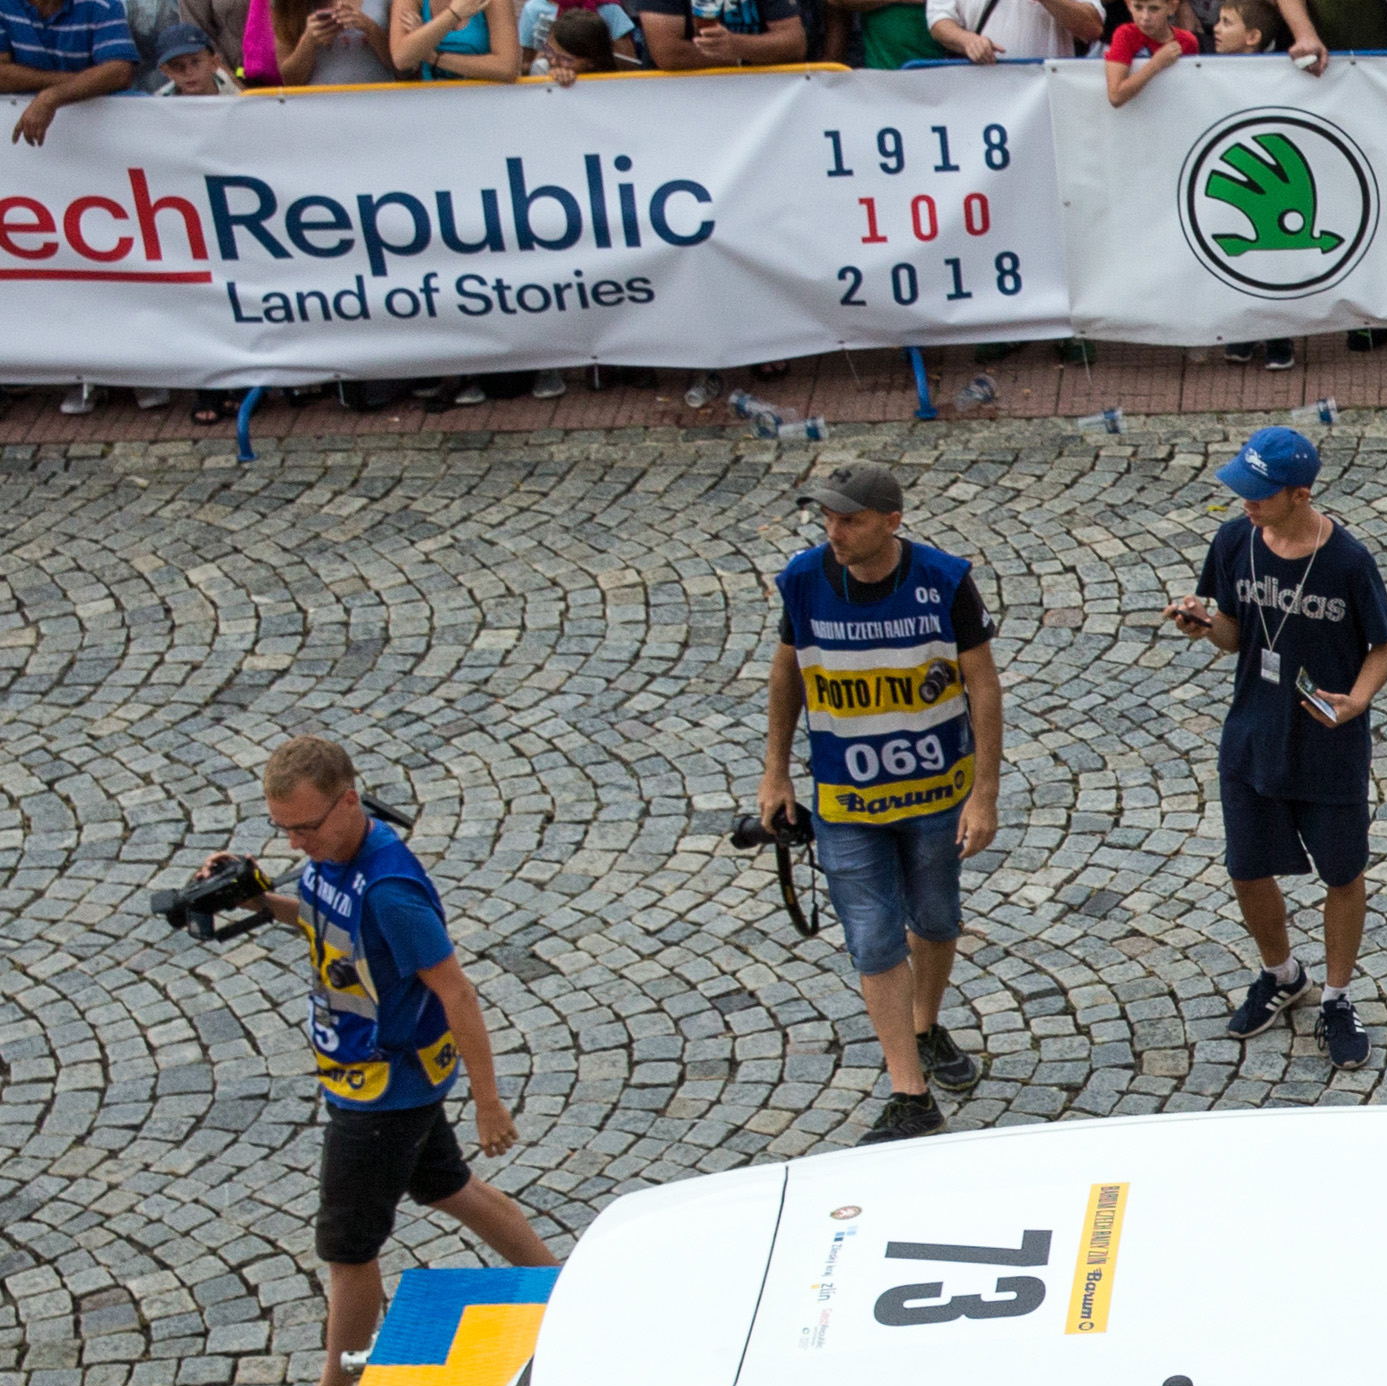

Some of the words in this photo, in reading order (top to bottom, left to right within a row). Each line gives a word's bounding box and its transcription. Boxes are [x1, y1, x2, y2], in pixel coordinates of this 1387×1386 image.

[227, 275, 372, 325] Land
[384, 272, 443, 321] of
[455, 268, 656, 317] Stories
[1236, 575, 1346, 622] adidas
[815, 674, 870, 710] POTO
[885, 676, 913, 705] TV
[845, 734, 945, 782] 069
[836, 785, 953, 815] Barum
[874, 1229, 1053, 1327] 73
[1080, 1268, 1102, 1319] Barum
